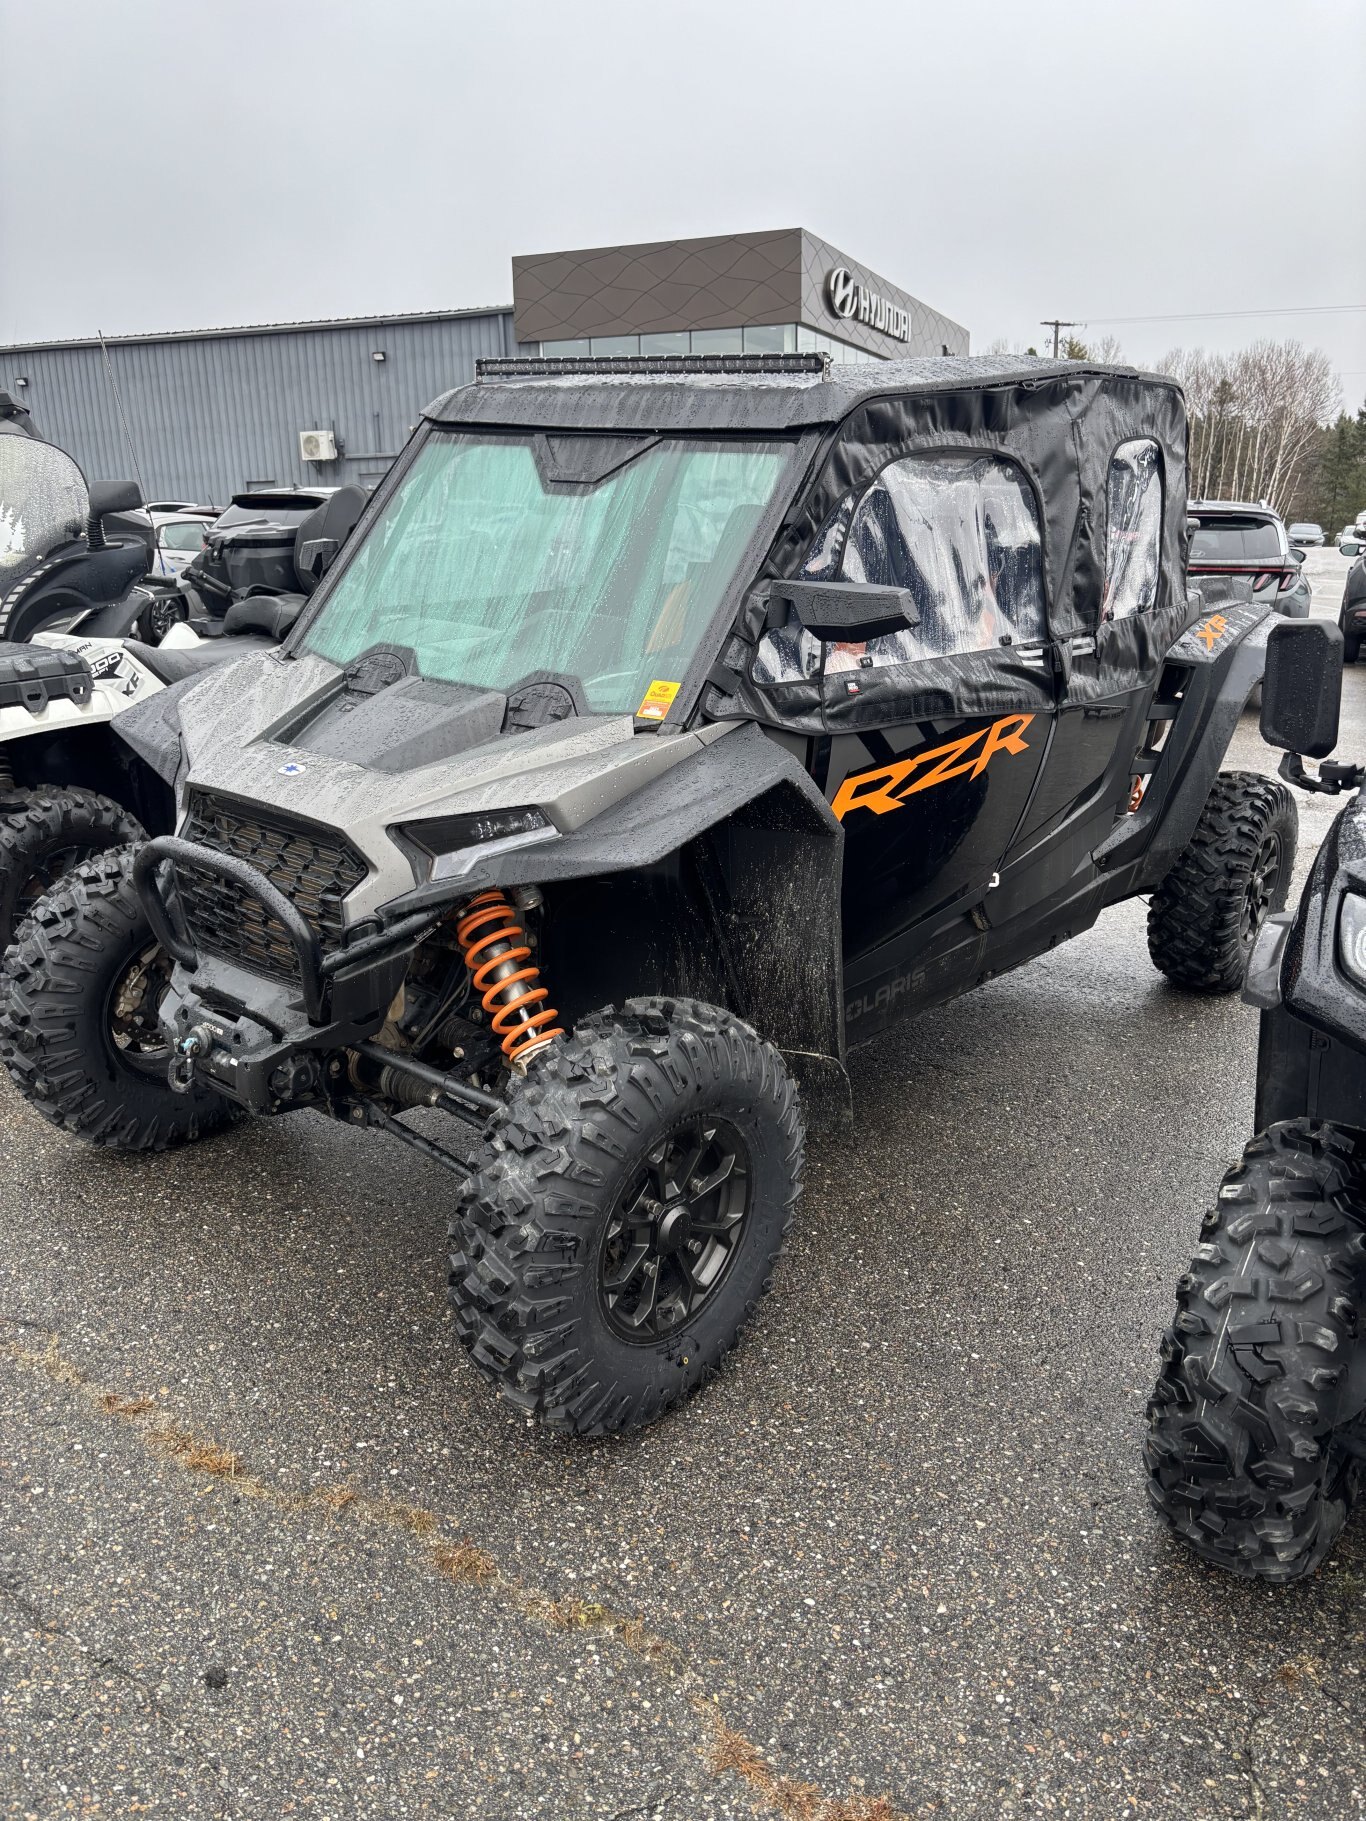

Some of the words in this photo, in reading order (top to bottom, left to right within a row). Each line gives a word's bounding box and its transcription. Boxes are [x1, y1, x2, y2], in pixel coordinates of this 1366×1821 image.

[857, 285, 912, 343] HYUNDAI
[1195, 614, 1227, 651] XP
[831, 713, 1036, 823] RZR
[845, 966, 926, 1022] OLARIS
